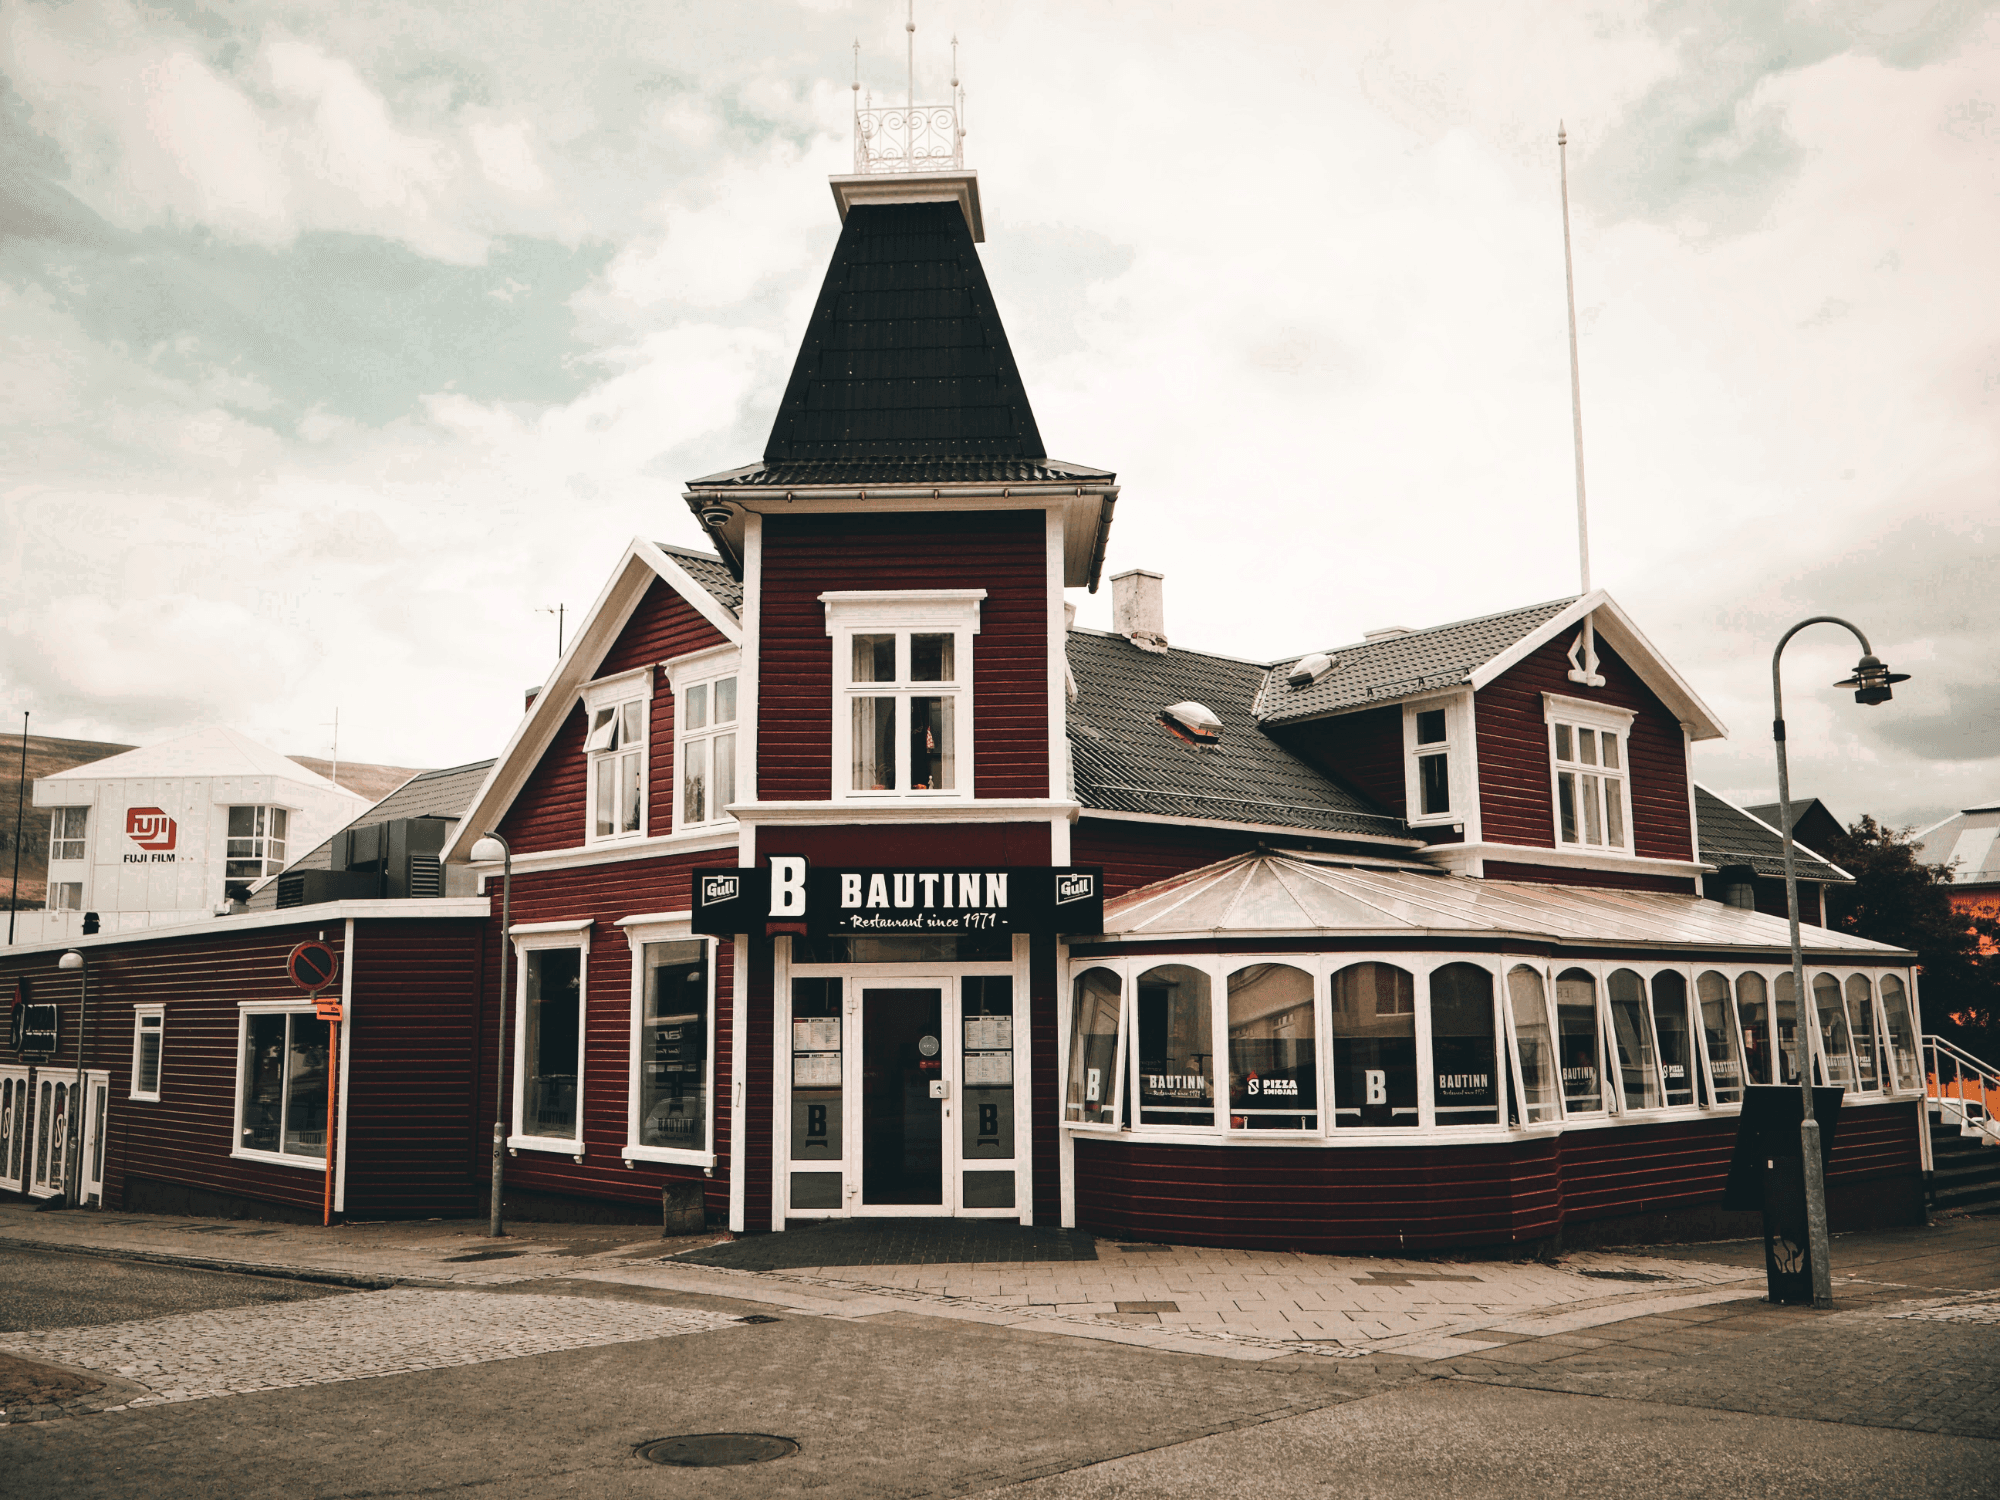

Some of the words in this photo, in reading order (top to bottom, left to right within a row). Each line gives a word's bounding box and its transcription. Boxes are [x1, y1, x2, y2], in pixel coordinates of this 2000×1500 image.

[124, 854, 147, 863] FUJI
[151, 854, 176, 863] FILM
[707, 880, 735, 897] Gull
[768, 856, 806, 917] B
[840, 873, 1009, 909] BAUTINN
[1061, 879, 1089, 896] Gull
[850, 913, 924, 929] Restaurant
[926, 914, 960, 928] since
[963, 912, 998, 930] 1971
[1086, 1068, 1101, 1101] B
[1149, 1075, 1205, 1089] BAUTINN
[1263, 1079, 1298, 1088] PIZZA
[1364, 1070, 1387, 1105] B
[1439, 1074, 1488, 1088] BAUTINN
[807, 1105, 826, 1136] B
[978, 1104, 998, 1135] B
